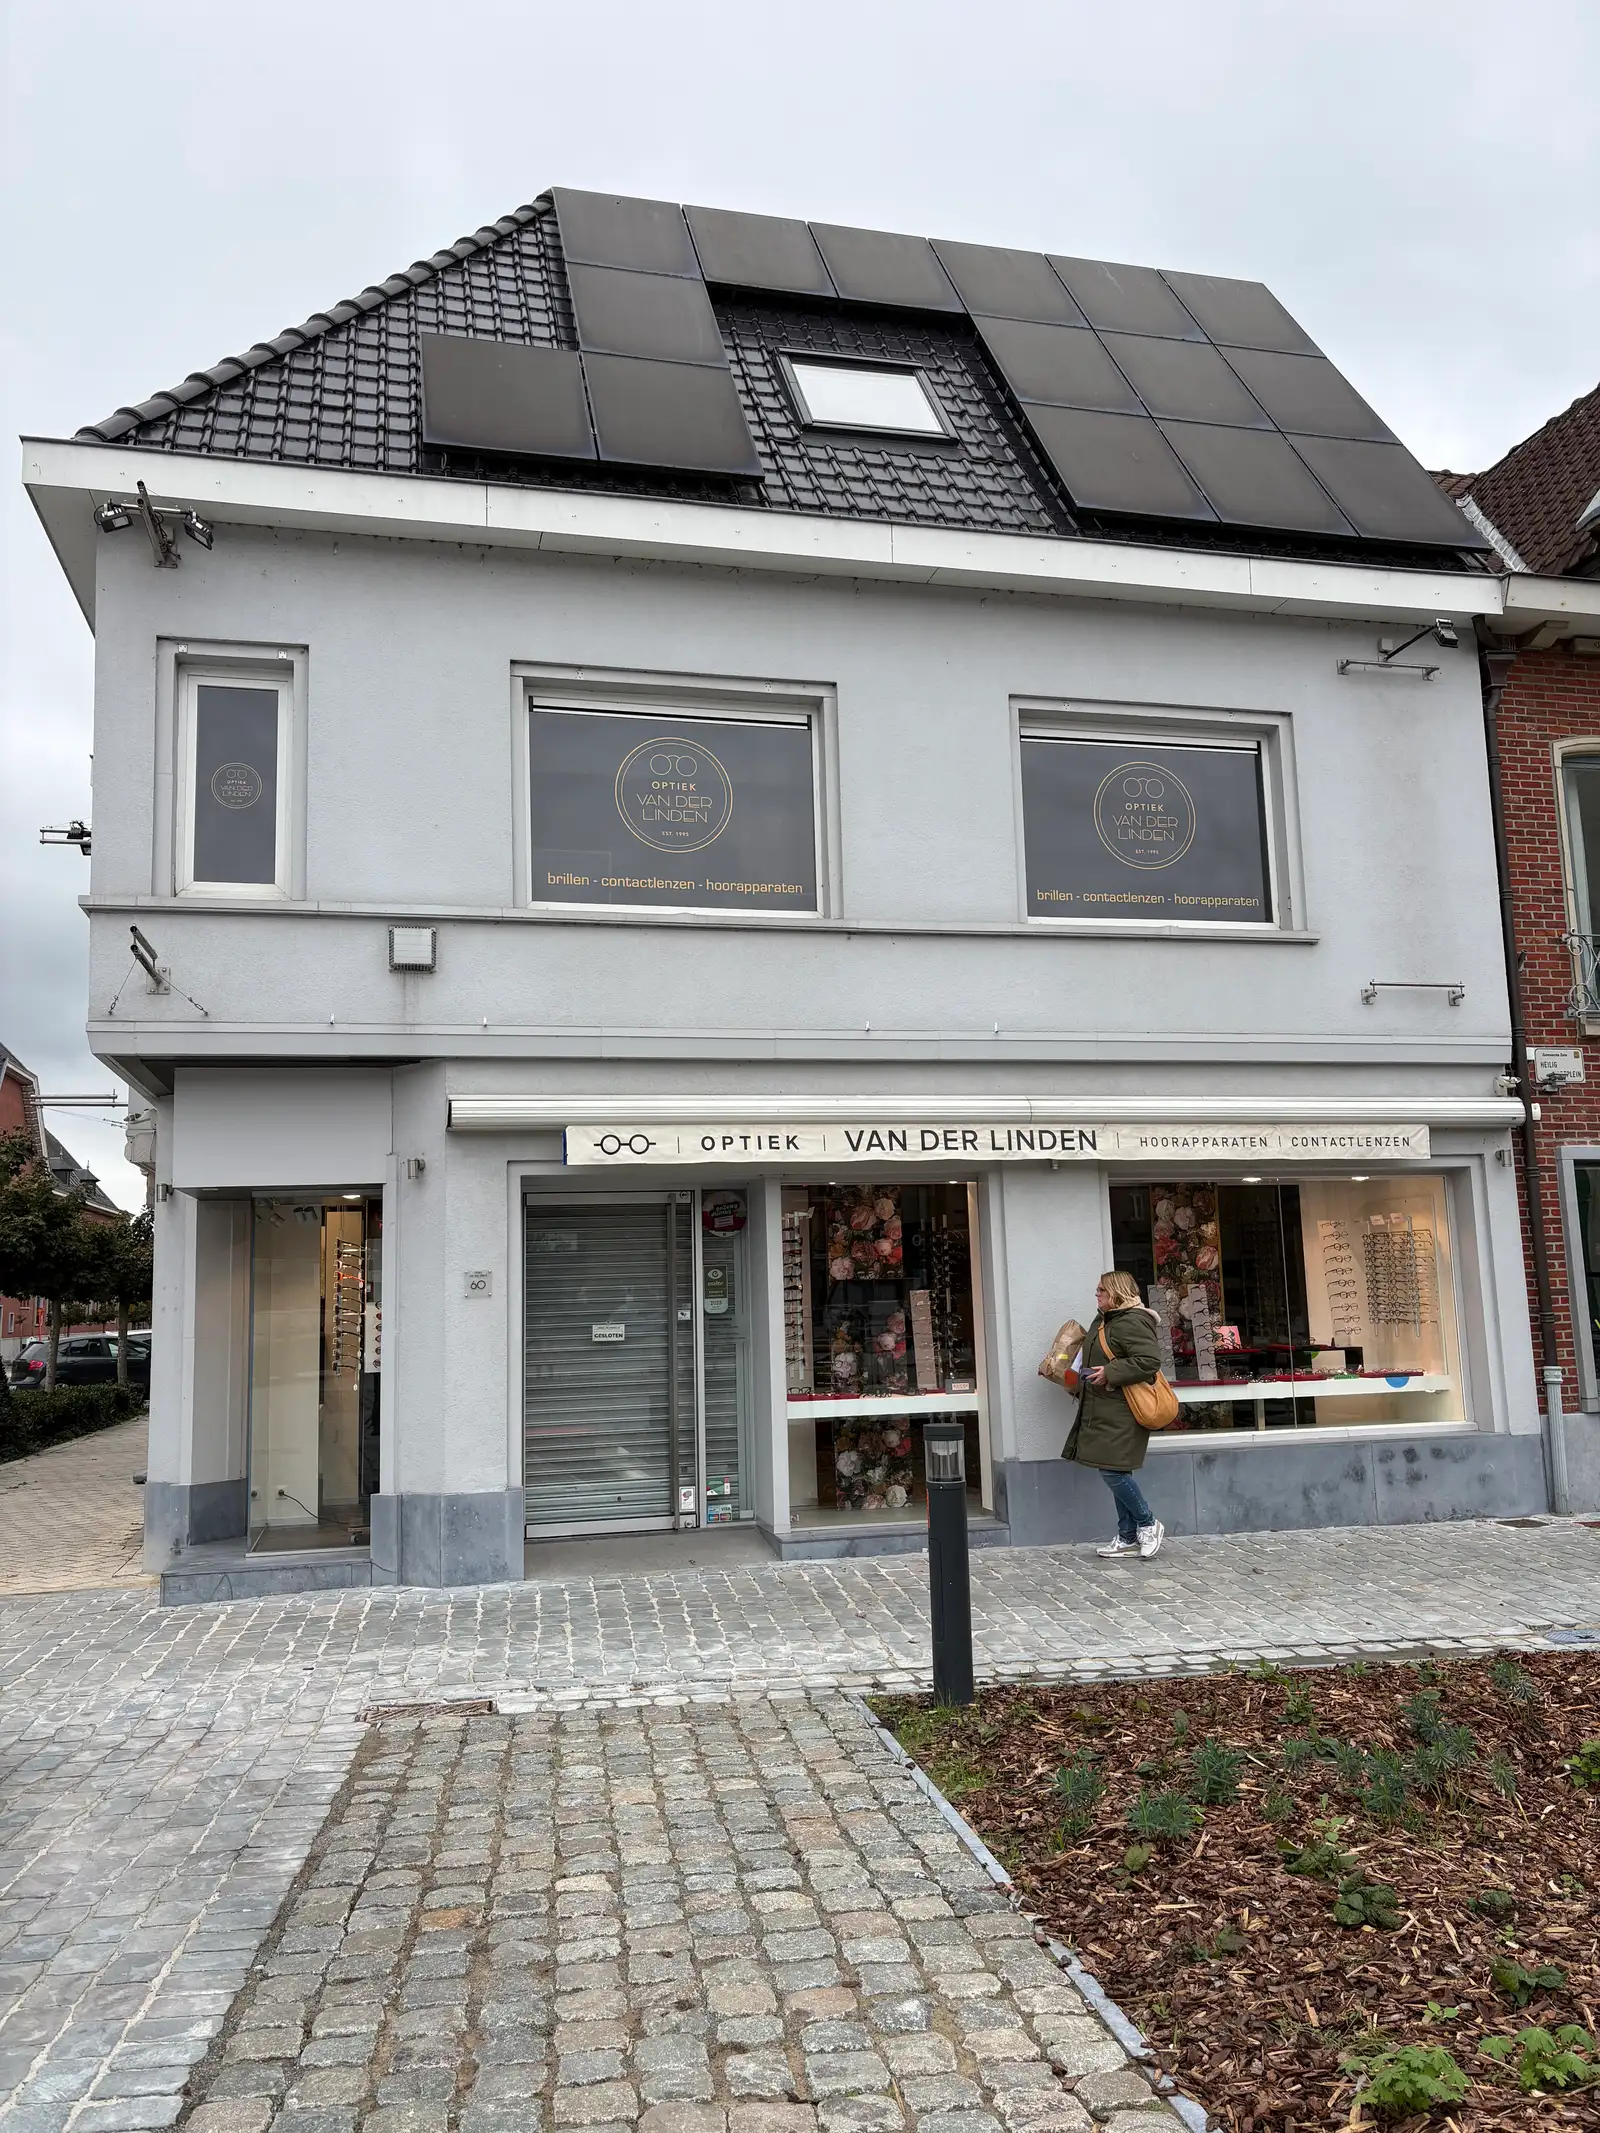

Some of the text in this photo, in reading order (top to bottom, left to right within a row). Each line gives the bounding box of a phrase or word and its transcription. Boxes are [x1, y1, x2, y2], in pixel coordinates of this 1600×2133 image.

[651, 781, 696, 791] OPTIEK
[636, 793, 712, 809] VAN DER
[1125, 803, 1164, 812] OPTIEK
[642, 808, 708, 823] LINDEN
[1112, 815, 1179, 828] VAN DER
[1117, 828, 1175, 841] LINDEN
[547, 872, 590, 886] brillen
[601, 876, 695, 890] contactlenzen
[706, 879, 803, 894] hoorapparaten
[1036, 889, 1073, 901] brillen
[1083, 891, 1165, 904] contactlenzen
[1174, 893, 1259, 908] hoorapparaten
[1540, 1061, 1557, 1069] HEILIG
[701, 1129, 1411, 1152] OPTIEK VAN DER LINDEN HOORAPPARATEN CONTACTLENZEN
[470, 1280, 486, 1290] 60
